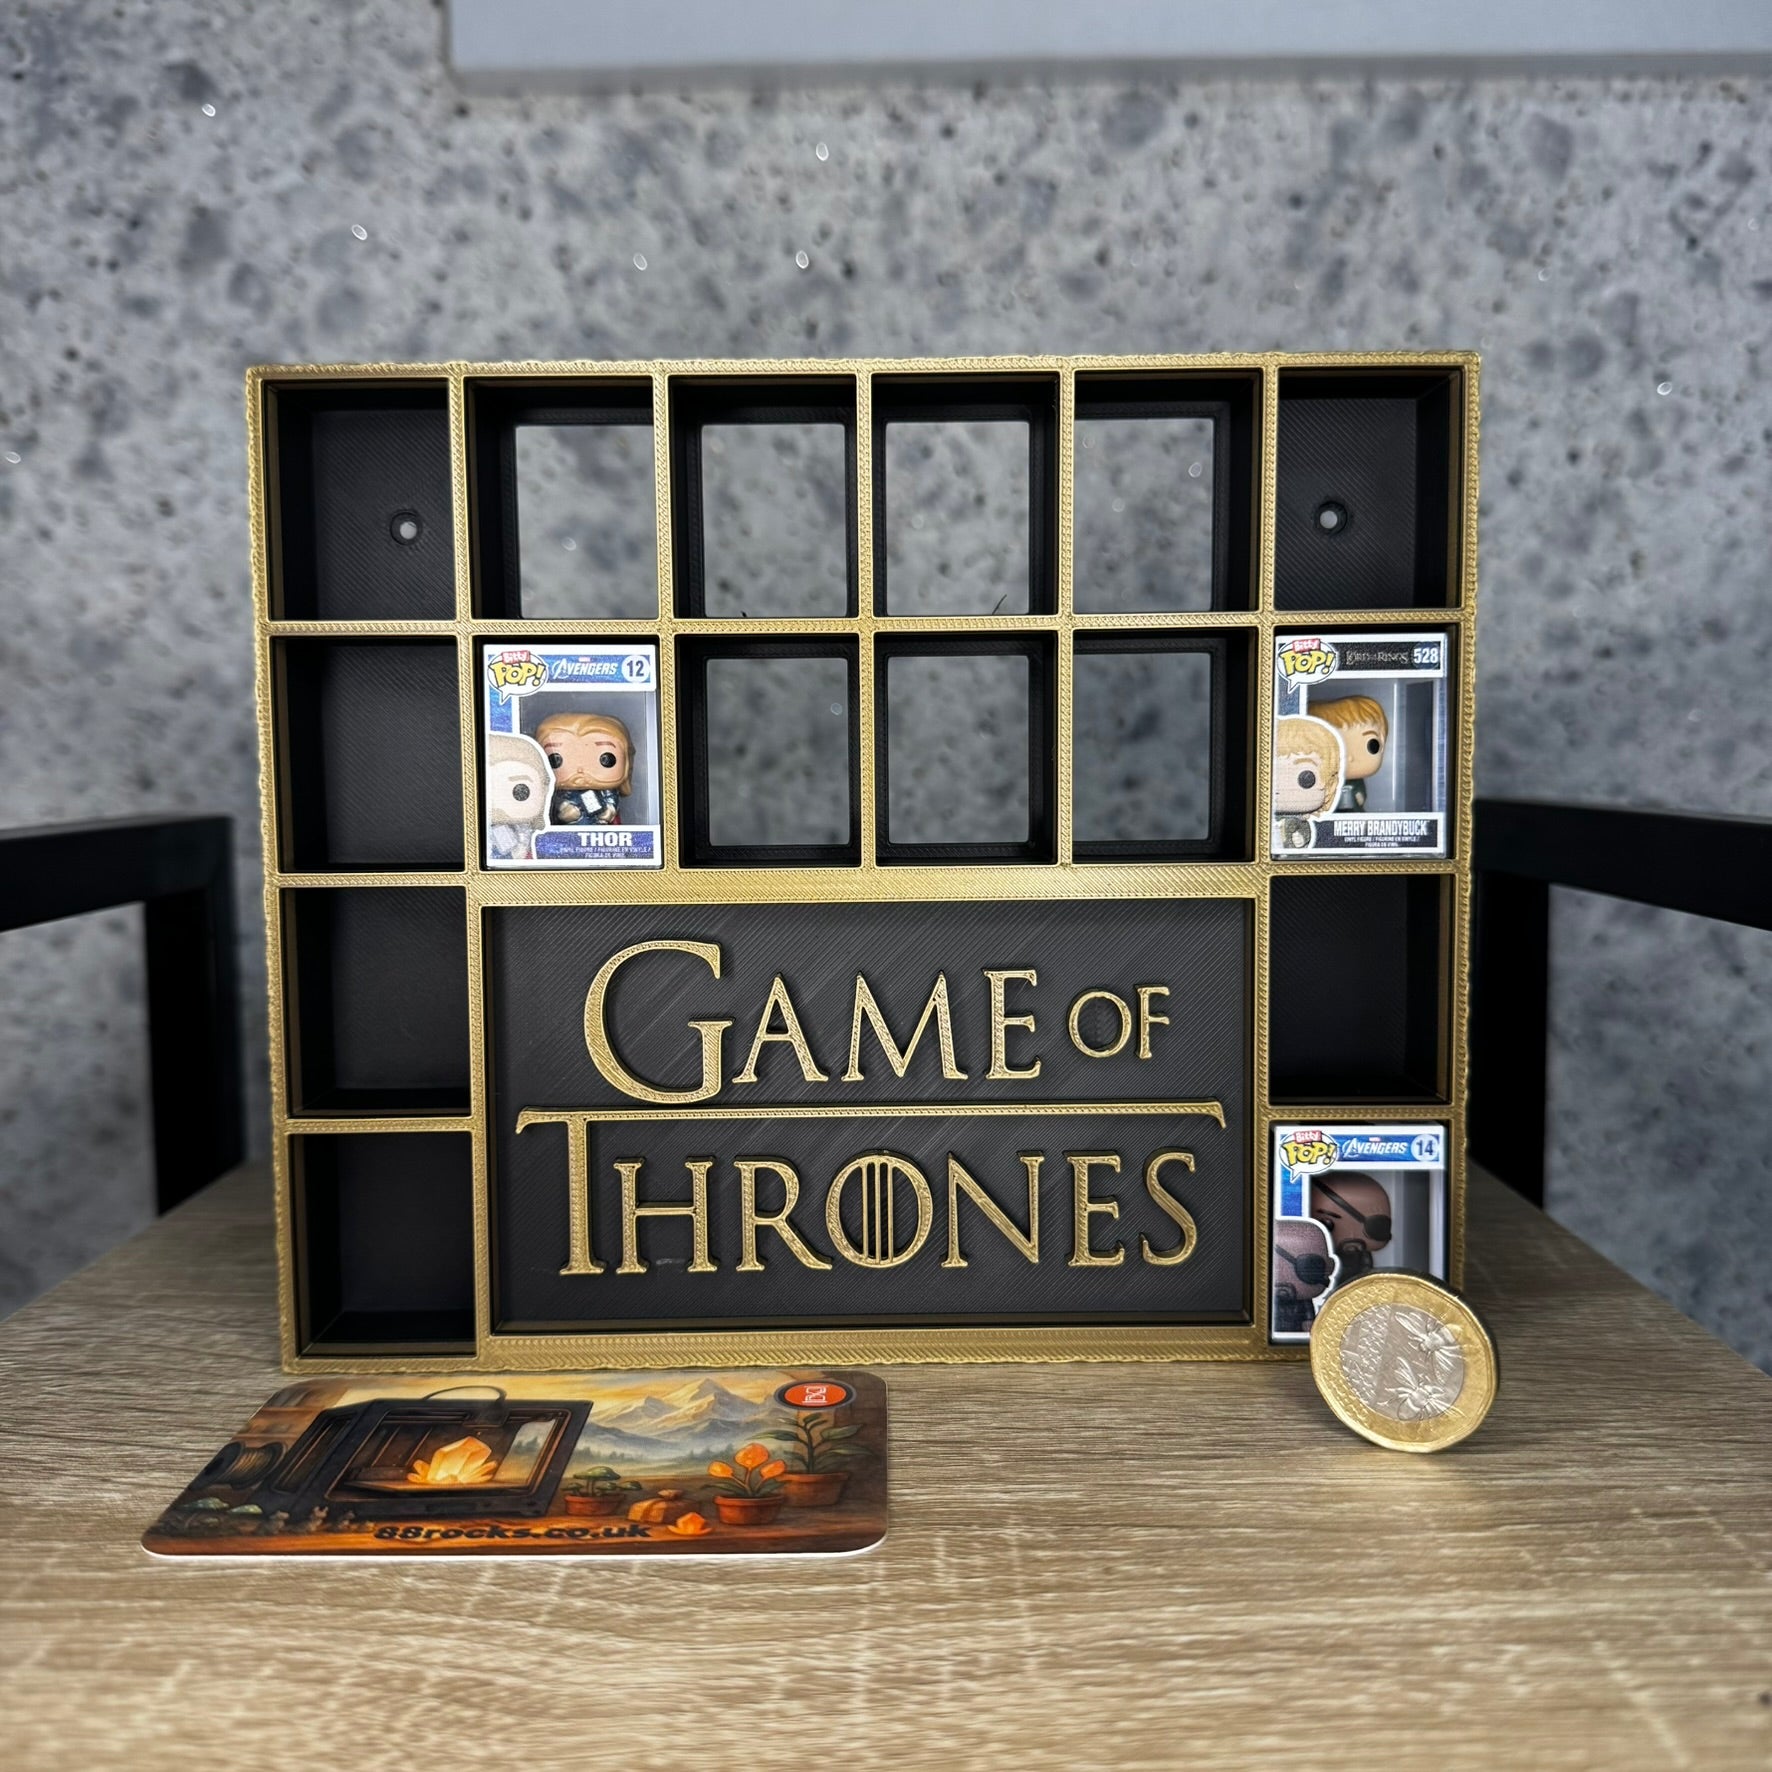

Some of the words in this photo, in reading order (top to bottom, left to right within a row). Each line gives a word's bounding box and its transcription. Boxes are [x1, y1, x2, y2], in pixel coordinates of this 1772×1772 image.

[1293, 639, 1320, 652] Bitty
[502, 651, 529, 662] Bitty
[1280, 650, 1336, 676] POP!
[1413, 647, 1439, 664] 528
[488, 661, 546, 687] POP!
[552, 658, 619, 680] AVENGERS
[627, 660, 645, 677] 12
[1333, 820, 1366, 836] MERRY
[1367, 819, 1428, 836] BRANDYBUCK
[577, 832, 633, 847] THOR
[583, 939, 1043, 1103] GAME
[1067, 983, 1170, 1060] OF
[1294, 1131, 1322, 1143] Bitty
[1282, 1141, 1337, 1166] POP!
[1342, 1137, 1409, 1158] AVENGERS
[1416, 1139, 1434, 1156] 14
[516, 1099, 1226, 1275] THRONES
[373, 1524, 651, 1539] 88rocks.co.uk
